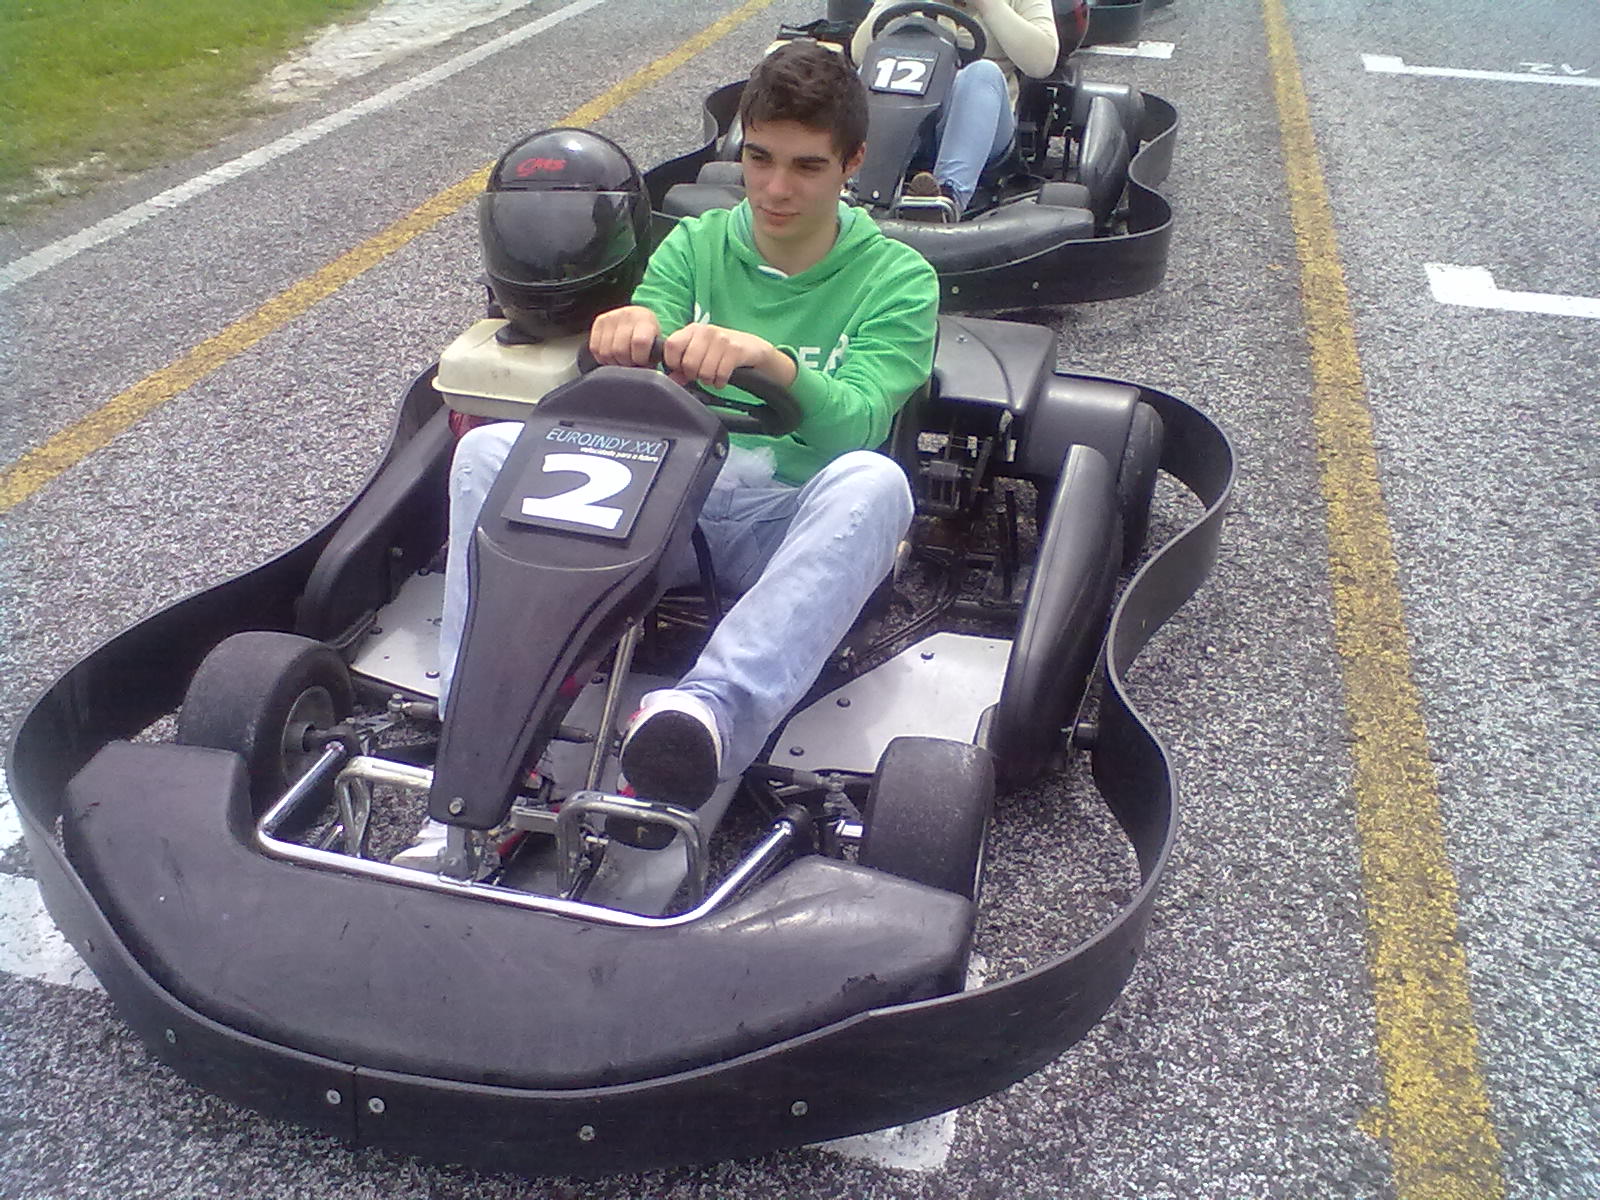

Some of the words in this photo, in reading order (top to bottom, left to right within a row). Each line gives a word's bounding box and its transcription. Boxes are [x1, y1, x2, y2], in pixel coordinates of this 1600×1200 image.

[874, 57, 926, 92] 12
[545, 427, 630, 451] EUROINDY
[630, 440, 662, 455] XXI
[521, 453, 633, 530] 2
